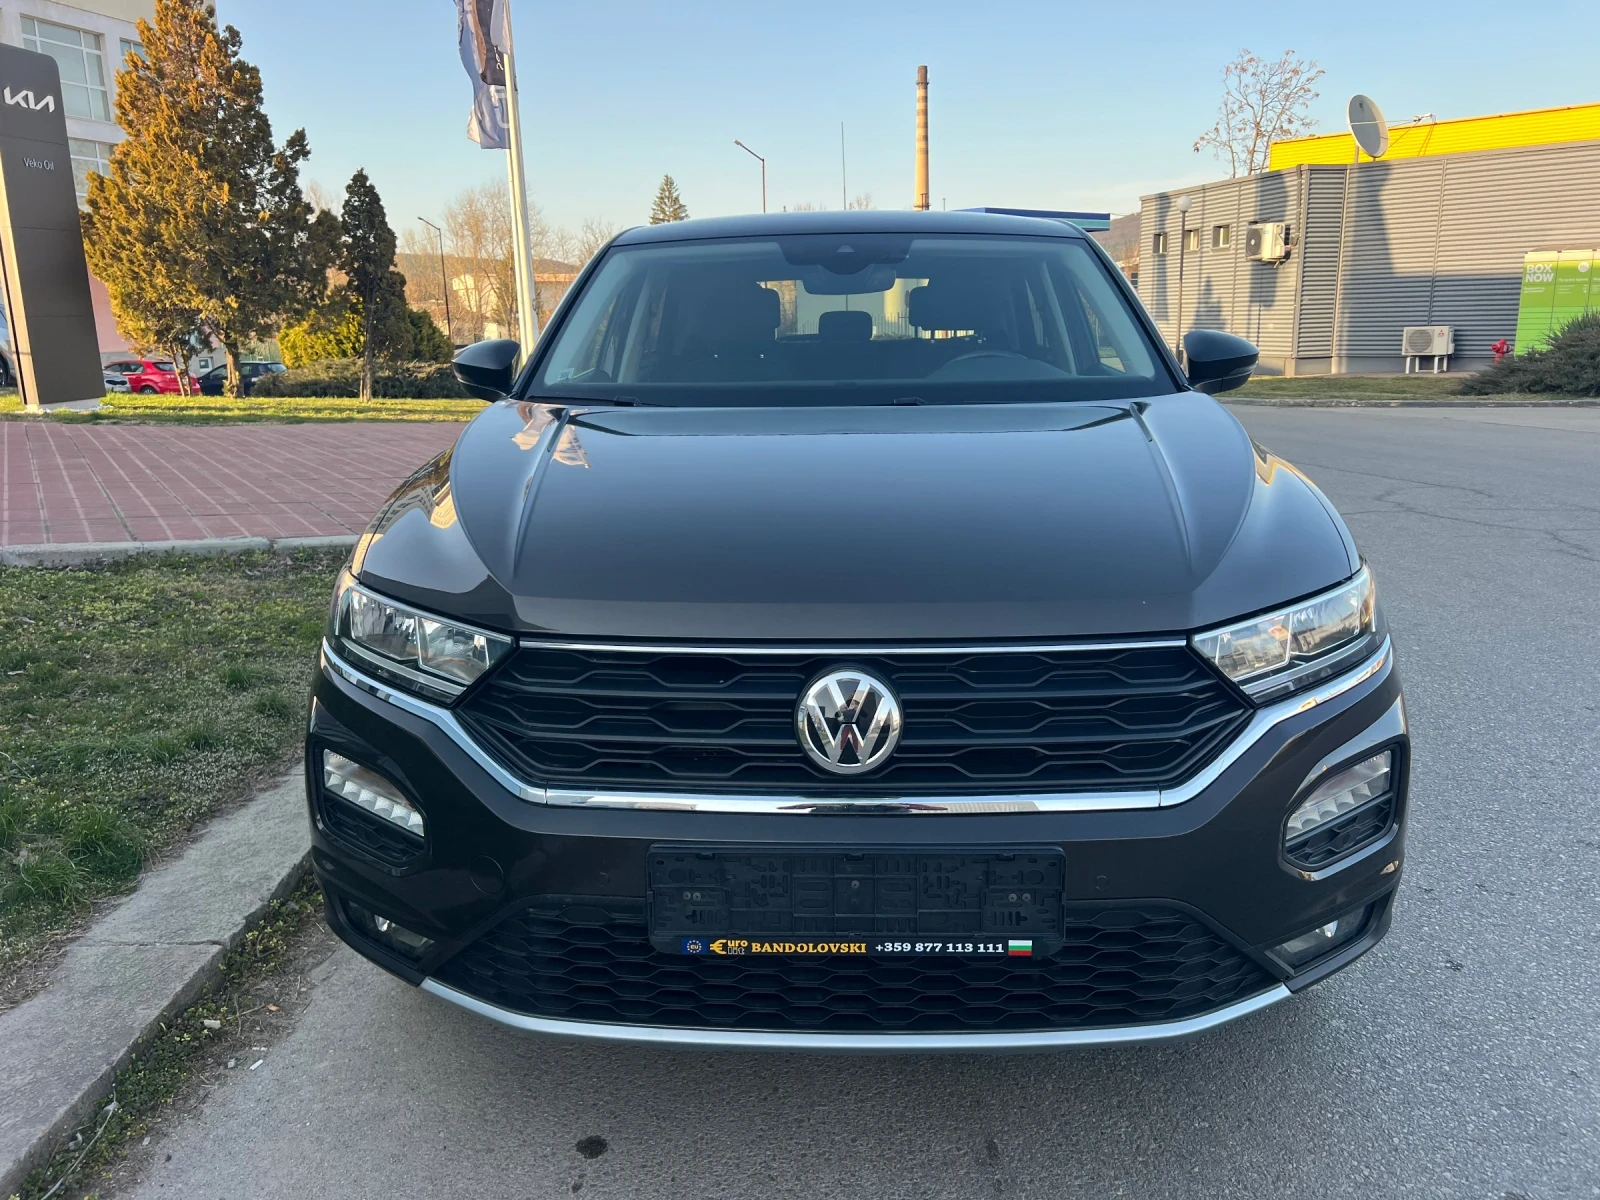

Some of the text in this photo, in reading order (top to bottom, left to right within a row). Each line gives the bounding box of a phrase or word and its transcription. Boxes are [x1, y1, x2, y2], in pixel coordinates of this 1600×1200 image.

[23, 157, 54, 171] Veko Oil
[1526, 263, 1553, 273] BOX
[1525, 273, 1554, 283] NOW
[800, 674, 897, 771] VW
[751, 942, 867, 954] BANDOLOVSKI
[875, 942, 911, 952] +359
[915, 942, 942, 953] 877
[946, 943, 973, 953] 113
[977, 943, 1005, 953] 111
